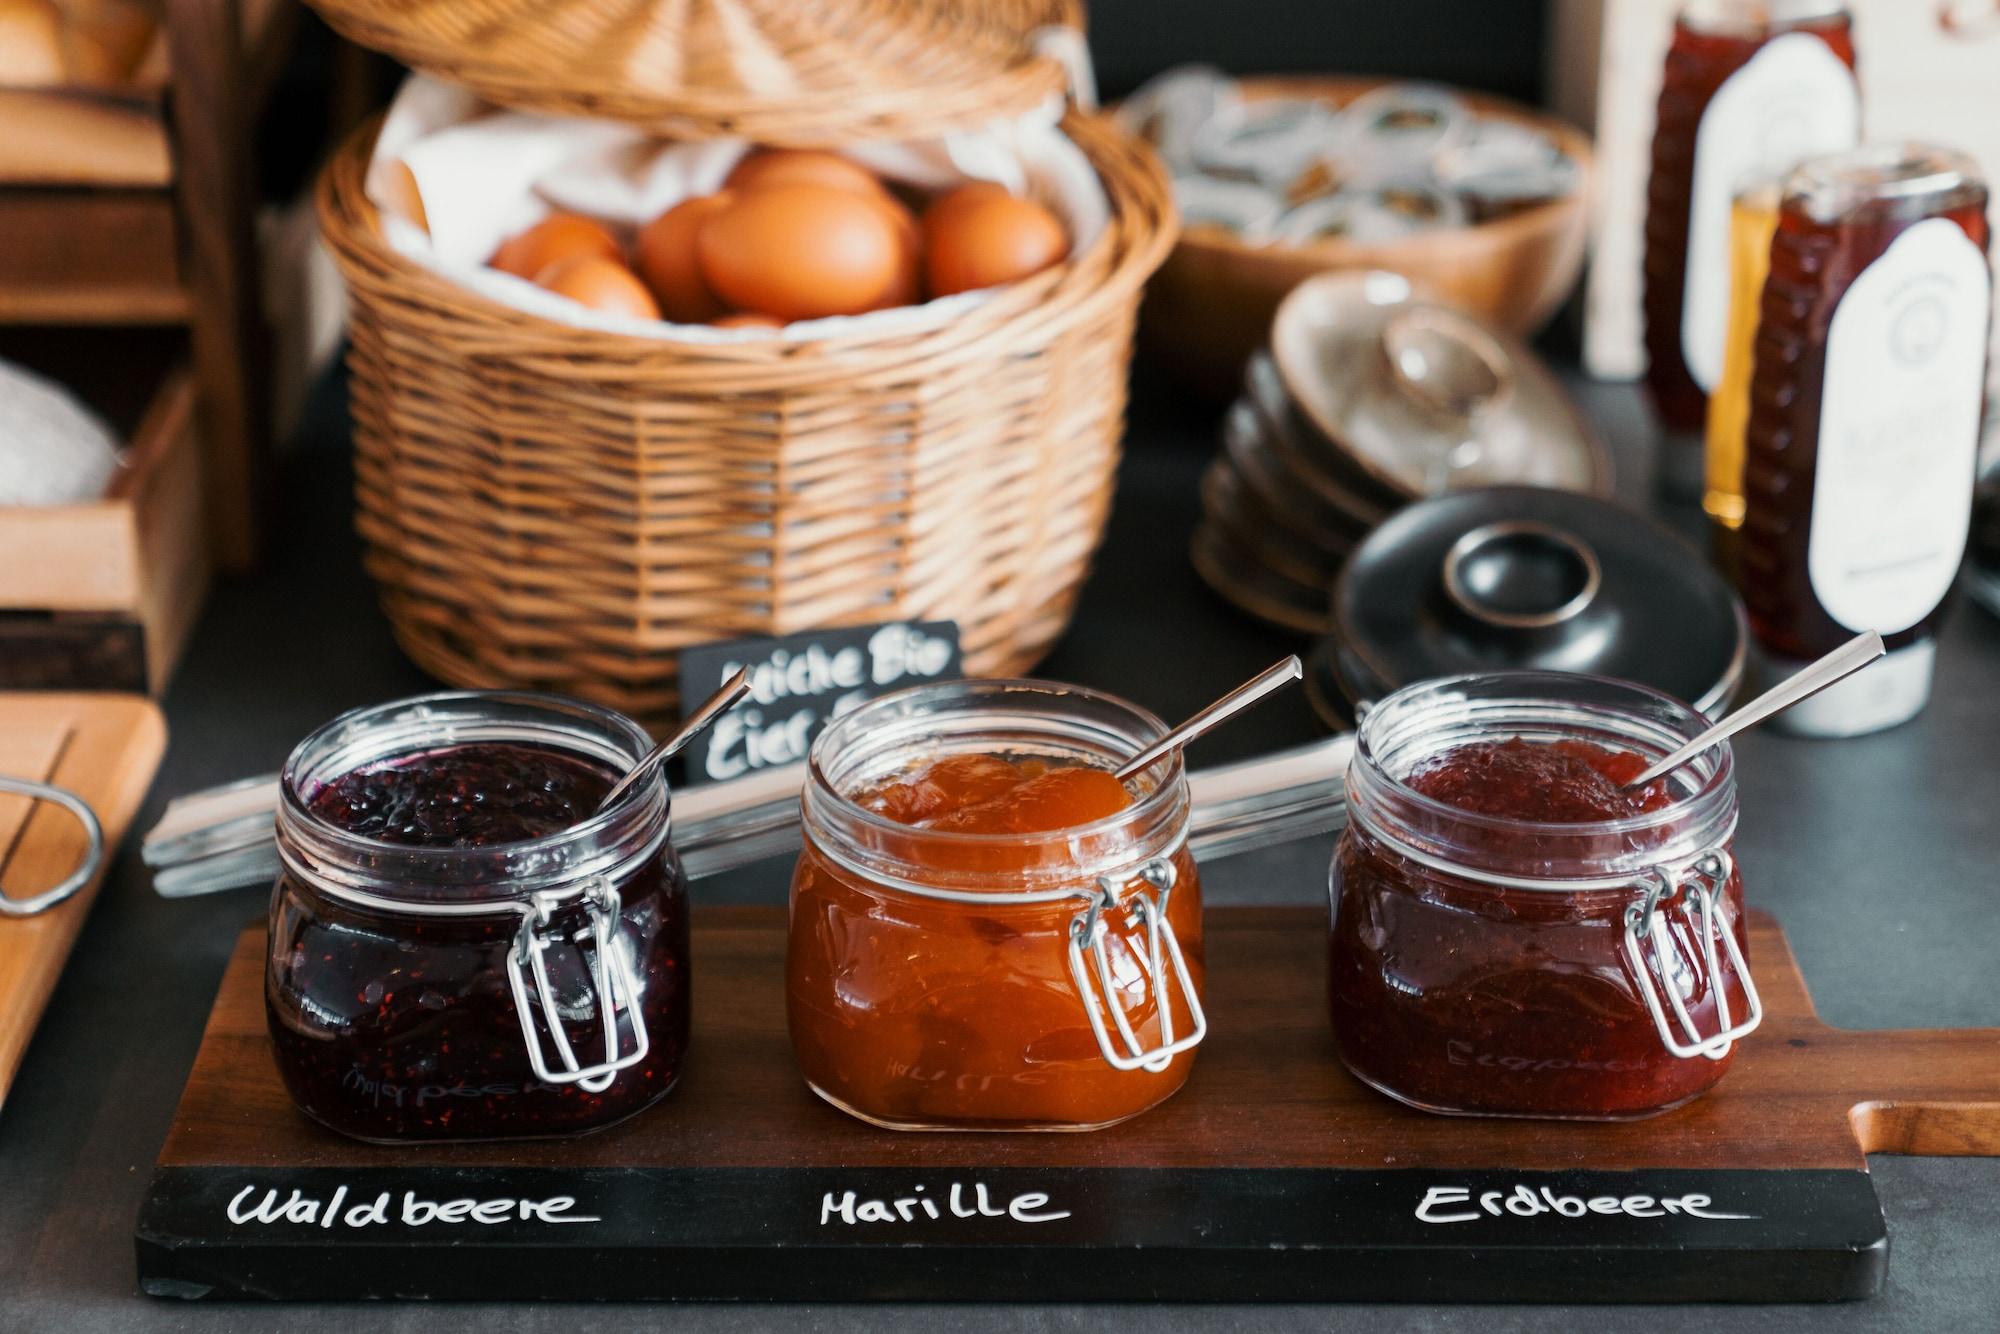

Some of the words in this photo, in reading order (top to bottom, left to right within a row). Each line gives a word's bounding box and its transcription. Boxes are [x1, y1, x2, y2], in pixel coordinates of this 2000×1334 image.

[868, 623, 951, 685] Bio
[226, 1185, 601, 1228] Waldbeere
[820, 1183, 1072, 1225] Marille
[1415, 1184, 1762, 1224] Erdbeere
